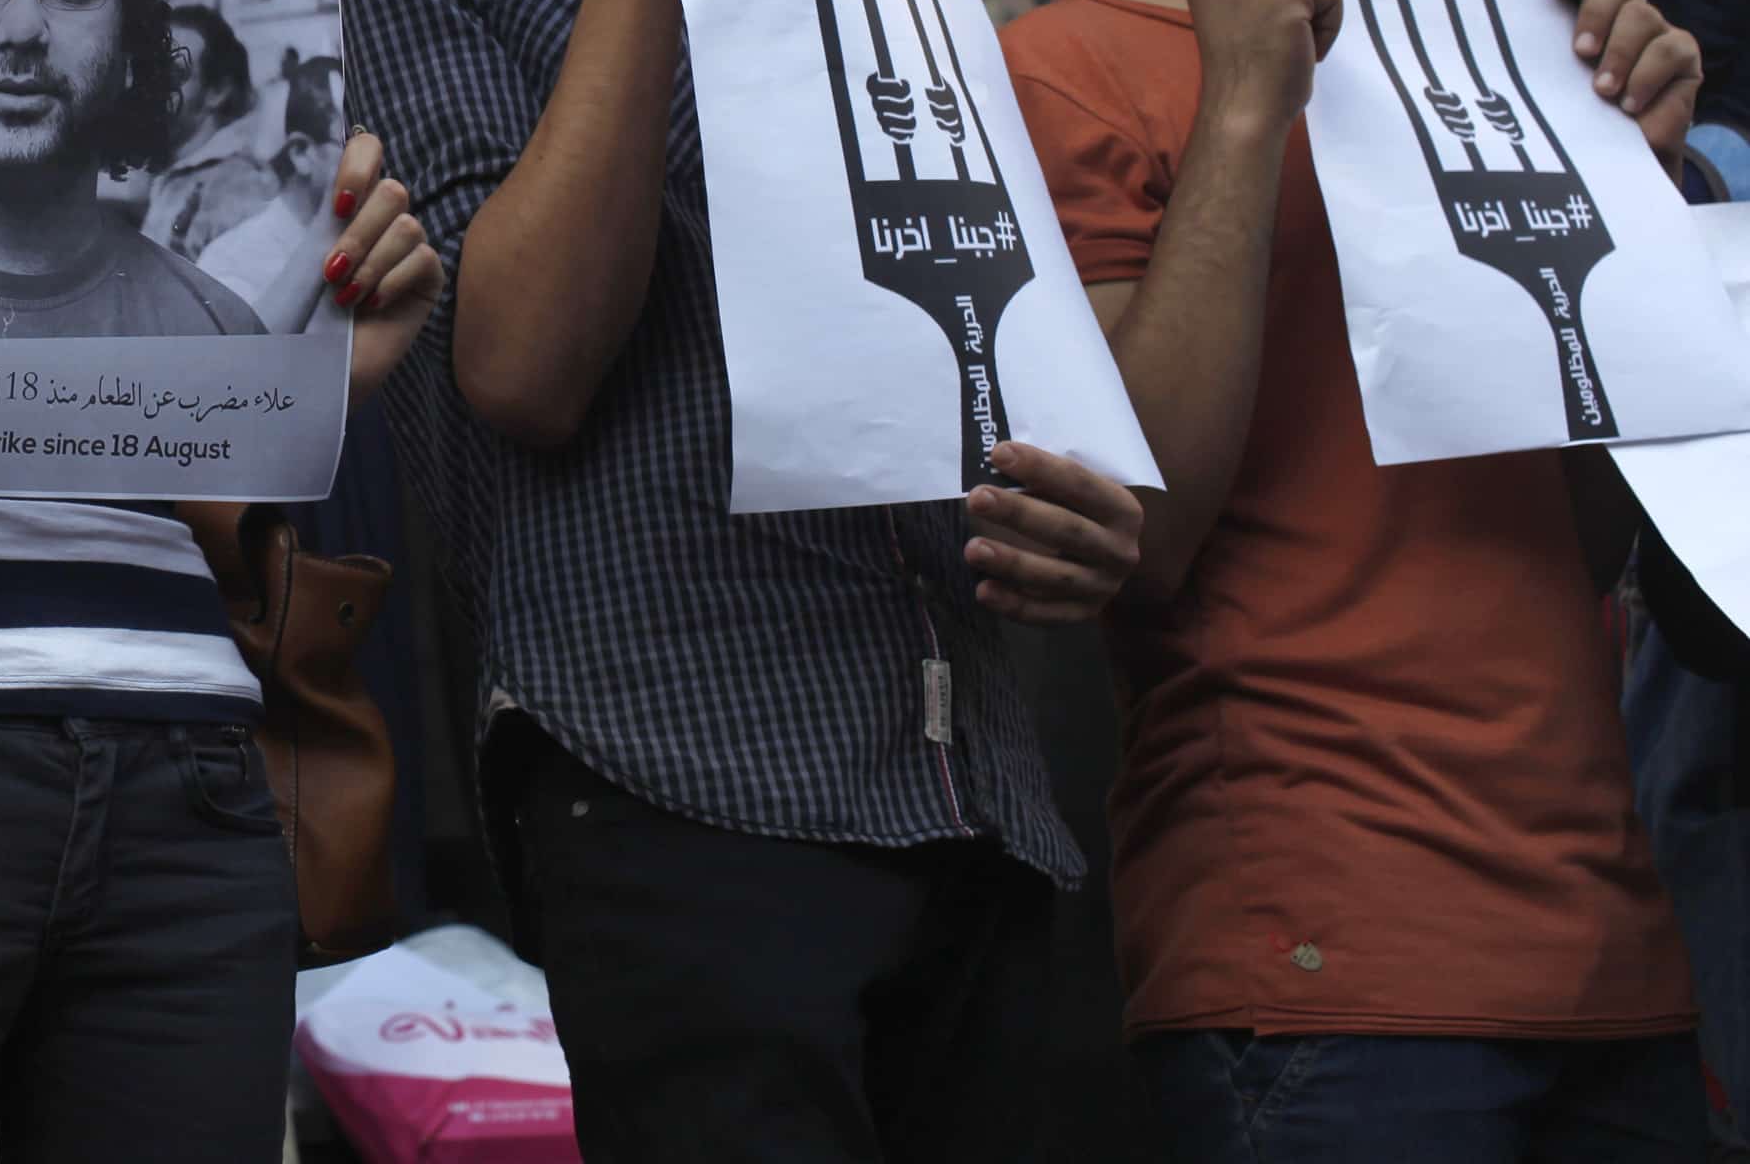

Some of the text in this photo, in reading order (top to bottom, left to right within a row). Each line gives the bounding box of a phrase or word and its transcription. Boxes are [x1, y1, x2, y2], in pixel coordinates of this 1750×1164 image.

[955, 295, 984, 354] الحرية
[1539, 267, 1603, 426] الحرية للمظلومين
[6, 371, 39, 401] 18
[46, 379, 78, 405] منذ
[80, 374, 143, 410] الطعام
[178, 385, 248, 422] مضرب
[254, 387, 295, 413] علاء
[144, 389, 176, 419] عن
[42, 432, 106, 457] since
[110, 433, 139, 457] 18
[143, 434, 232, 467] August
